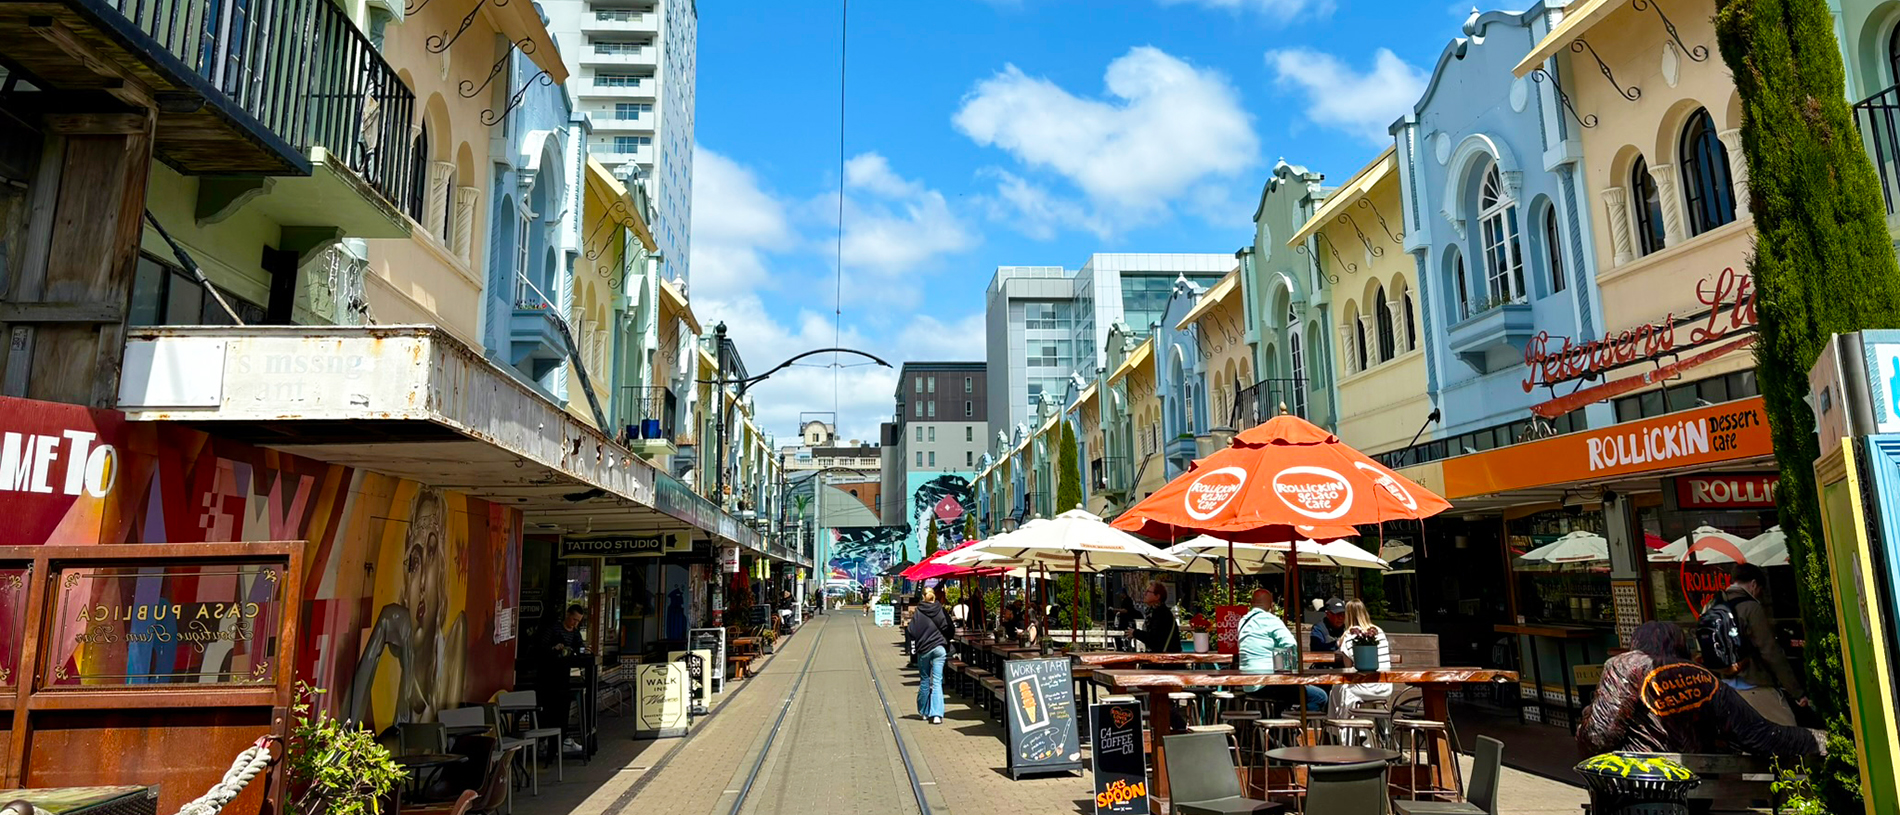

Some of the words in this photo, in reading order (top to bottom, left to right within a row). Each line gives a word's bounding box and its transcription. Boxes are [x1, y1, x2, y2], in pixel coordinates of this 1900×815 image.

[1522, 313, 1674, 393] Petersens
[566, 540, 613, 551] TATTOO
[614, 538, 660, 549] STUDIO
[1010, 662, 1036, 678] WORK
[1042, 659, 1069, 674] TART
[646, 677, 677, 686] WALK
[1654, 688, 1701, 710] GELATO
[1100, 727, 1112, 739] C4
[1101, 733, 1133, 750] COFFEE
[1097, 781, 1146, 810] SPOON
